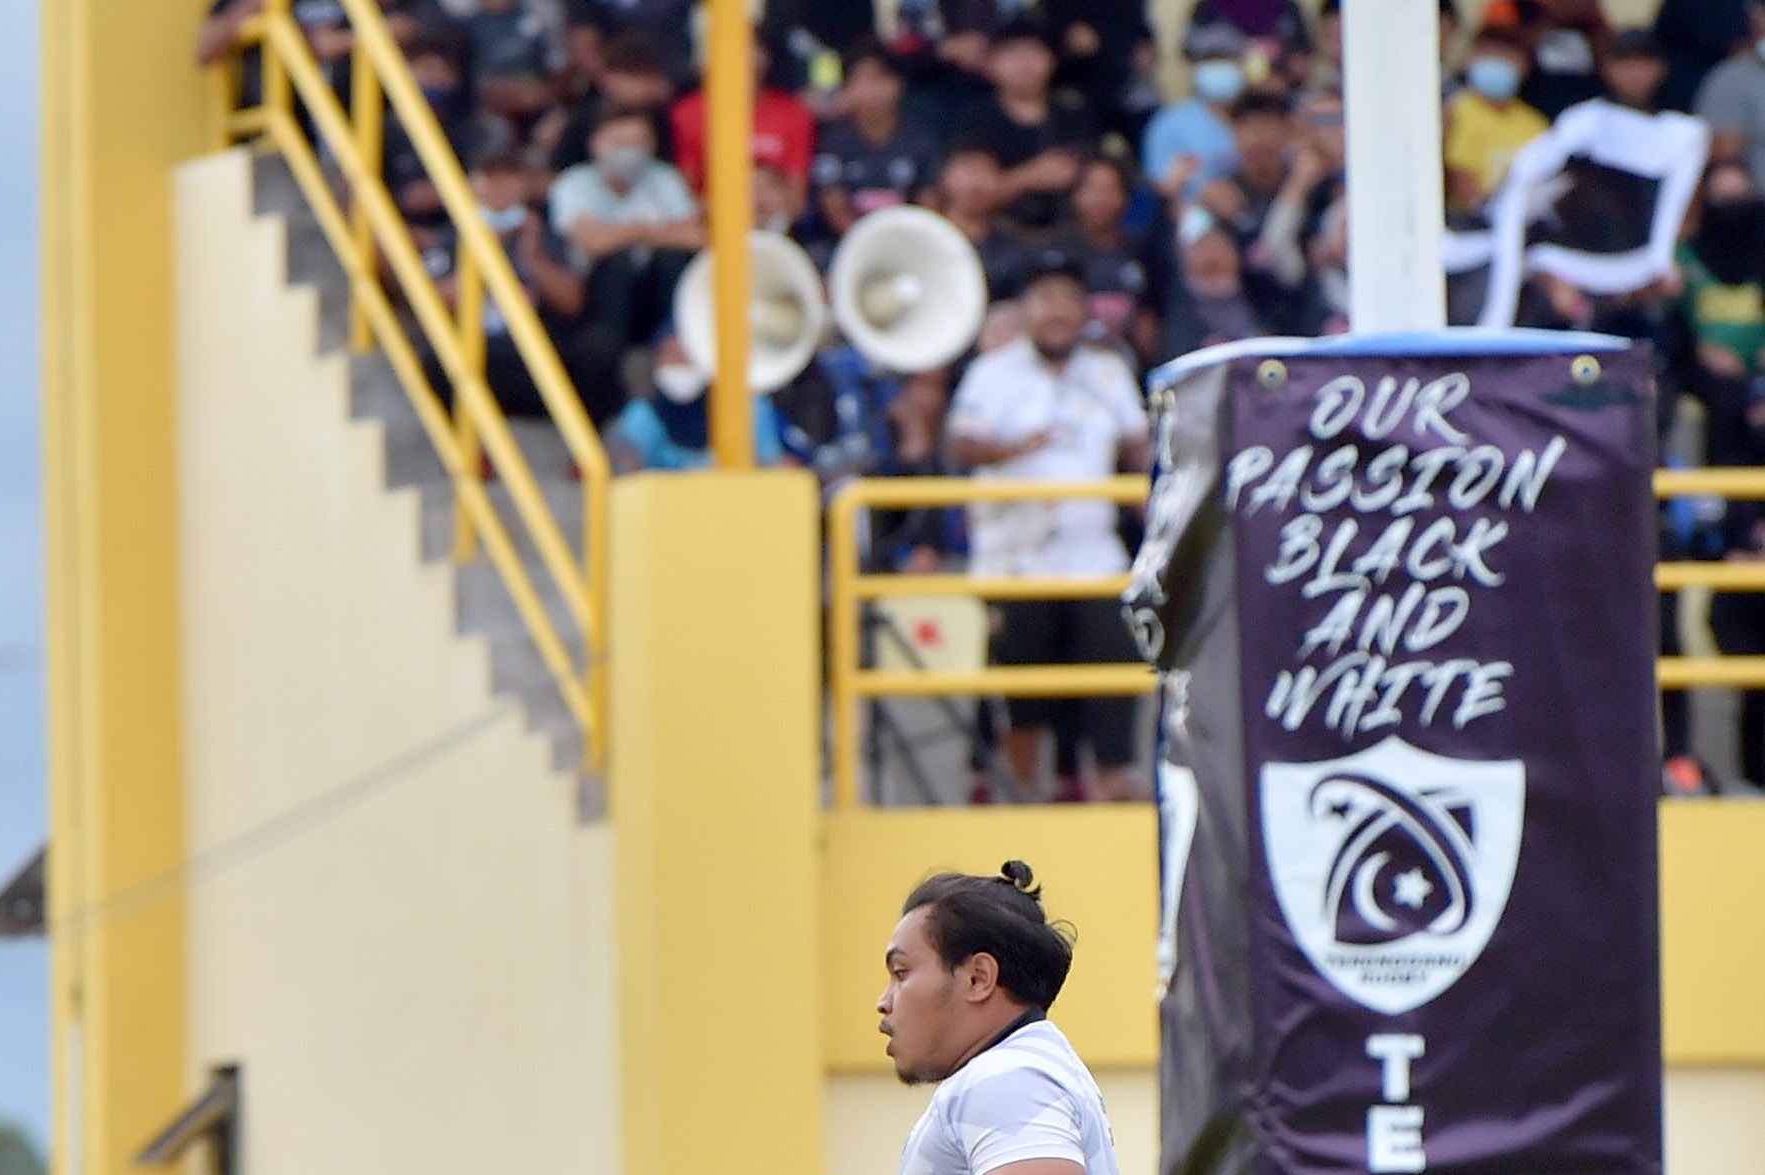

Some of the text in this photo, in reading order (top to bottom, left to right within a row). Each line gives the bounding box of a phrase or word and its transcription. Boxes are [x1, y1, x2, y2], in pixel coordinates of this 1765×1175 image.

[1308, 371, 1472, 446] OUR
[1226, 435, 1568, 515] PASSION
[1265, 513, 1510, 599] BLACK
[1296, 578, 1471, 661] AND
[1265, 651, 1514, 741] WHITE
